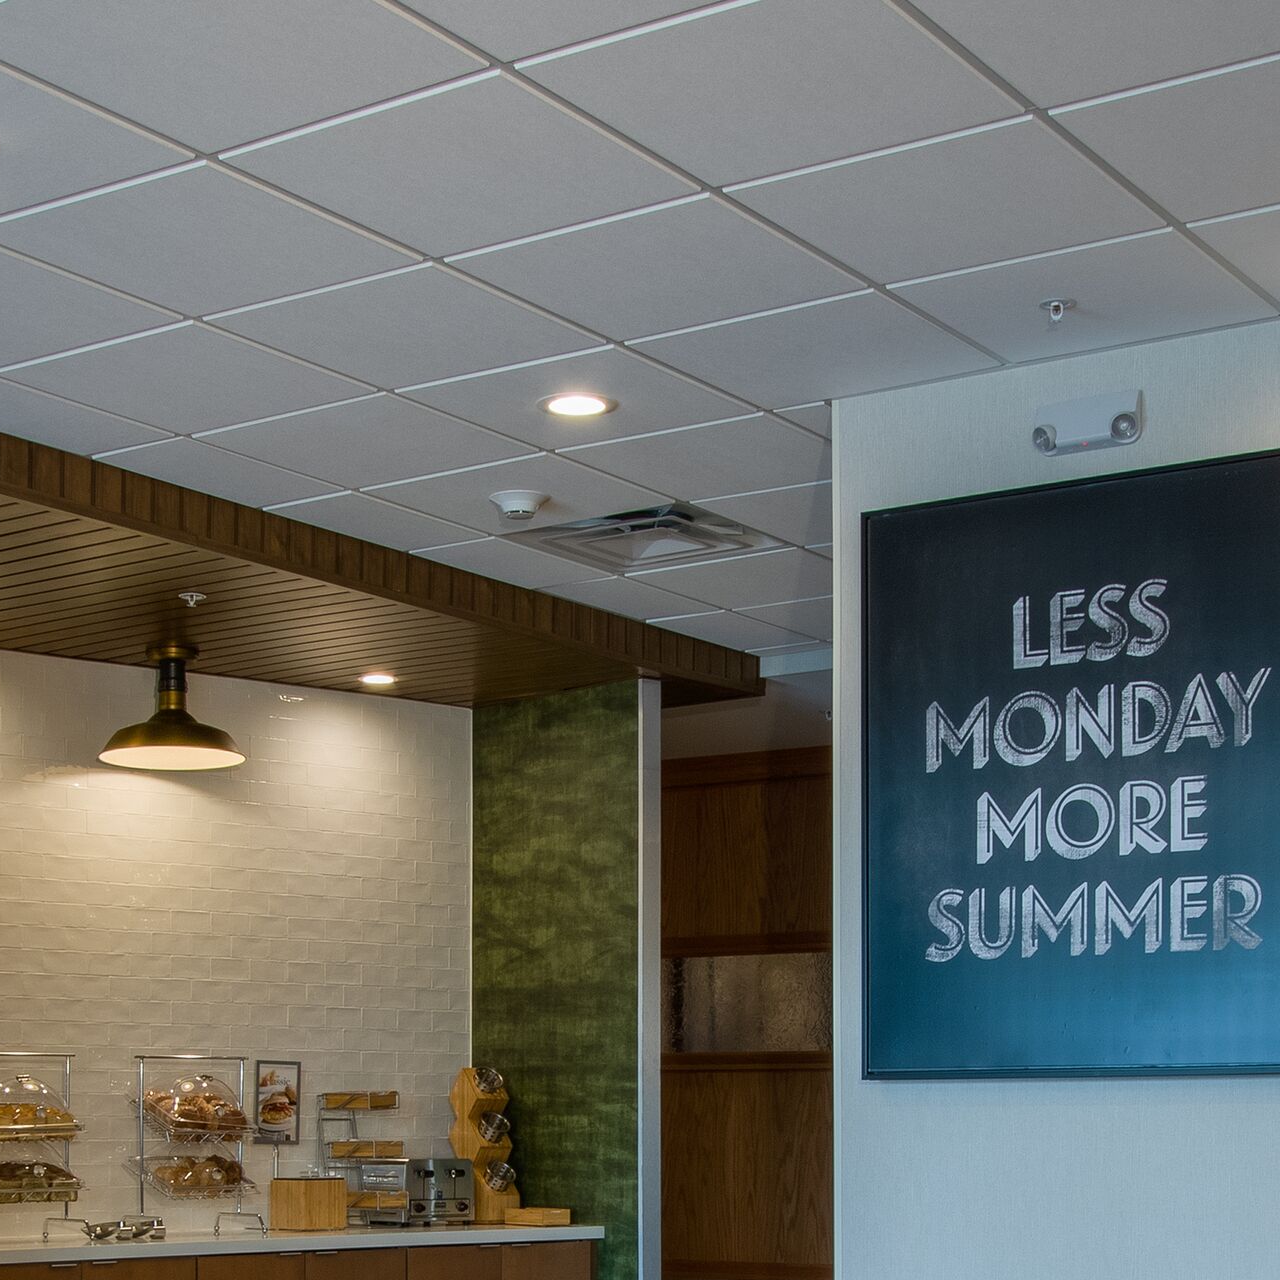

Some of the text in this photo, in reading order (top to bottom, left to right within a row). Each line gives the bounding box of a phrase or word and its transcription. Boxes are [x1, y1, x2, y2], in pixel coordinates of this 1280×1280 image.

[1013, 578, 1170, 670] LESS
[926, 667, 1271, 773] MONDAY
[976, 775, 1208, 865] MORE
[925, 874, 1263, 963] SUMMER
